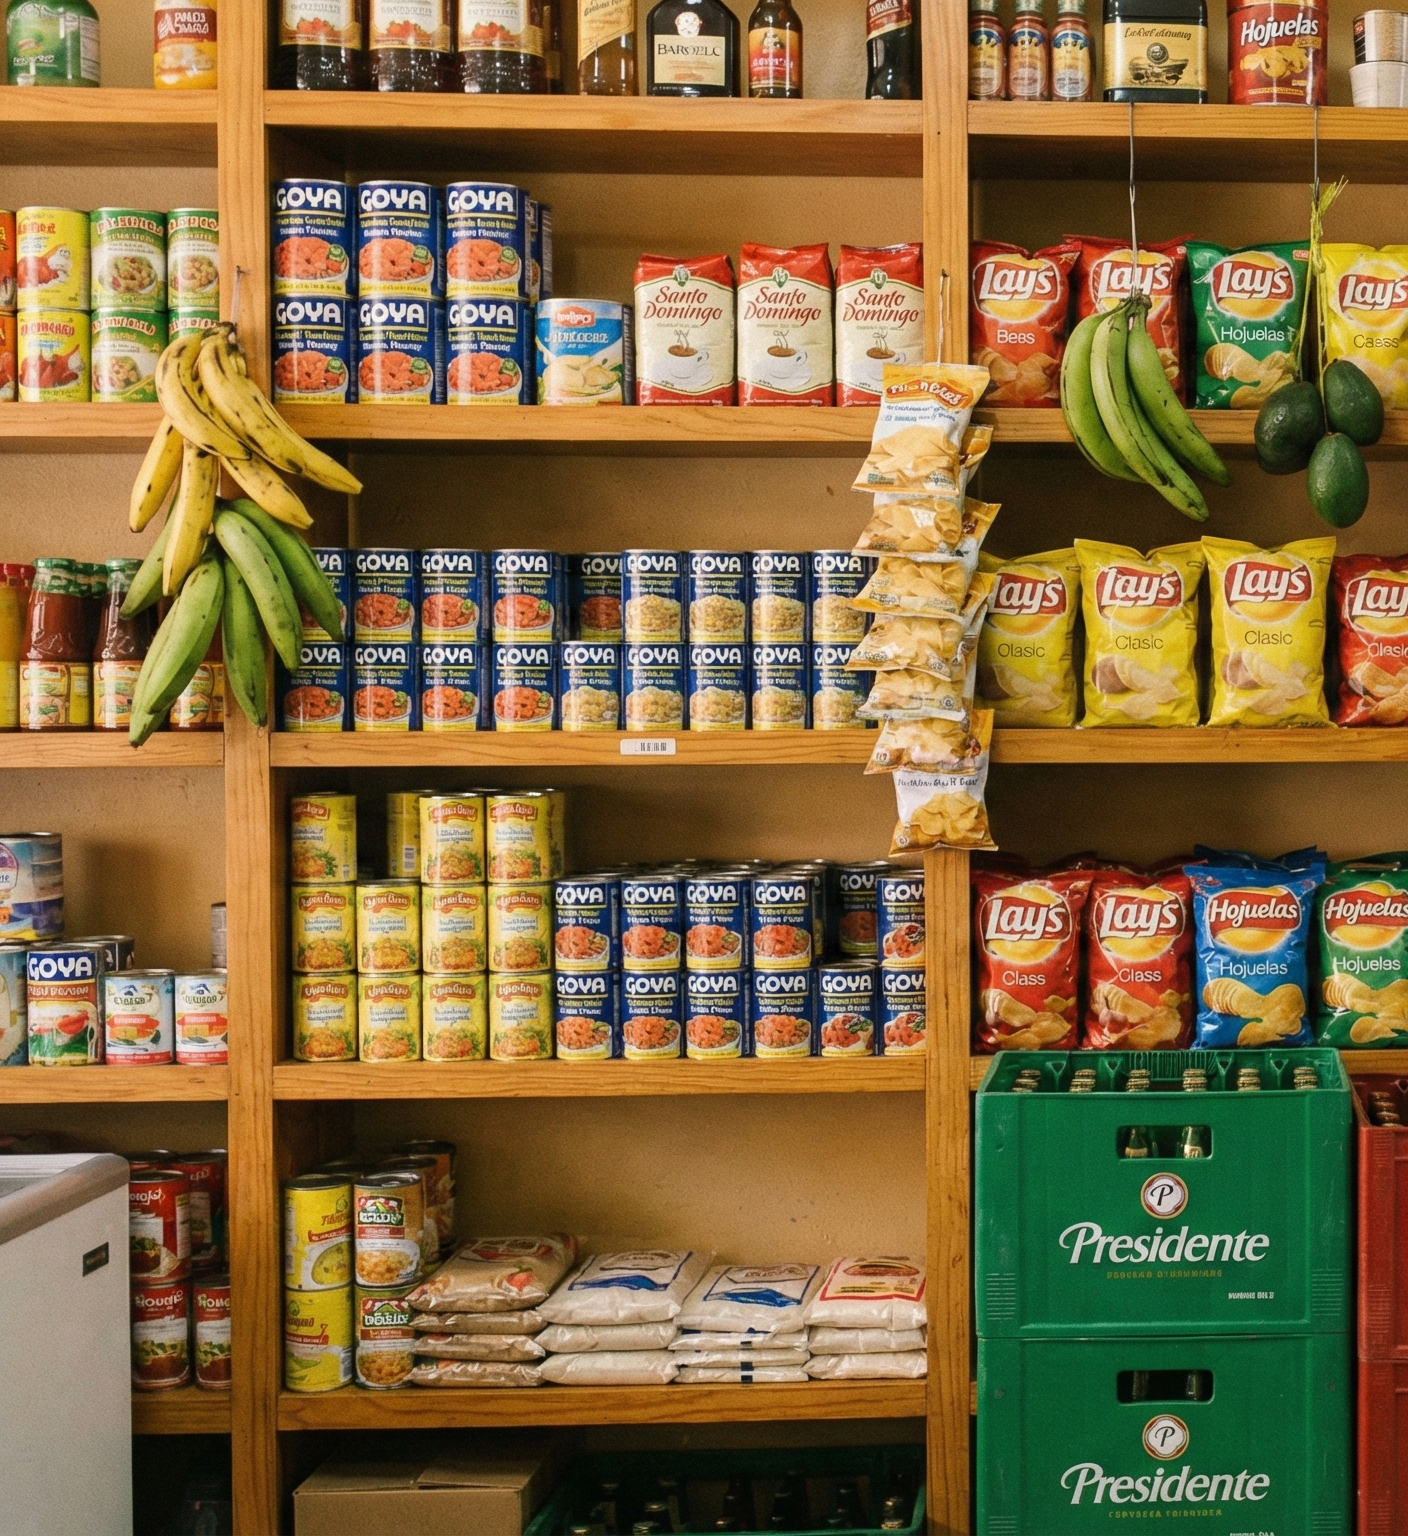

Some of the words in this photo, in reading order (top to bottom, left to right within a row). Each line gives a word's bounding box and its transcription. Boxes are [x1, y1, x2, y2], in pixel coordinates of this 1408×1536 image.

[1241, 12, 1320, 46] Hojuelas
[276, 187, 342, 212] GOYA
[360, 188, 427, 213] GOYA
[448, 189, 515, 214] GOYA
[979, 263, 1053, 301] Lay's
[1218, 262, 1289, 299] Lay's
[656, 286, 708, 305] Santo
[756, 286, 807, 305] Santo
[854, 288, 905, 307] Santo
[1342, 275, 1408, 311] Lay's
[276, 301, 342, 326] GOYA
[360, 302, 426, 327] GOYA
[448, 303, 515, 328] GOYA
[643, 302, 723, 326] Domingo
[744, 301, 822, 326] Domingo
[843, 303, 920, 328] Domingo
[1221, 326, 1285, 344] Hojuelas
[356, 554, 409, 573] GOYA
[422, 554, 472, 573] GOYA
[495, 555, 548, 574] GOYA
[581, 557, 622, 575] GOY
[691, 555, 741, 573] GOYA
[752, 555, 800, 573] GOYA
[814, 556, 862, 573] GOYA
[1101, 568, 1178, 608] Lay's
[1230, 563, 1307, 603] Lay's
[1115, 634, 1164, 651] Clasic
[300, 646, 341, 664] OYA
[355, 646, 407, 665] GOYA
[423, 647, 473, 665] GOYA
[496, 647, 549, 665] GOYA
[563, 647, 615, 665] GOYA
[628, 647, 679, 665] GOYA
[691, 647, 742, 665] GOYA
[753, 647, 801, 665] GOYA
[814, 647, 852, 665] GOY
[840, 874, 877, 893] GOY
[884, 883, 925, 902] GOY
[555, 885, 603, 906] GOYA
[623, 884, 676, 904] GOYA
[686, 884, 737, 905] GOYA
[755, 884, 806, 904] GOYA
[985, 899, 1066, 942] Lay's
[1099, 897, 1179, 939] Lay's
[1209, 897, 1298, 928] Hojuelas
[28, 957, 93, 980] GOYA
[1002, 970, 1046, 986] Class
[1219, 959, 1288, 979] Hojuelas
[556, 976, 606, 995] GOYA
[625, 975, 676, 995] GOYA
[687, 975, 738, 995] GOYA
[755, 974, 806, 994] GOYA
[822, 974, 872, 993] GOYA
[884, 974, 925, 993] GOY
[1150, 1183, 1174, 1206] P
[1059, 1221, 1270, 1264] Presidente
[1154, 1425, 1176, 1447] P
[1060, 1462, 1270, 1505] Presidente
